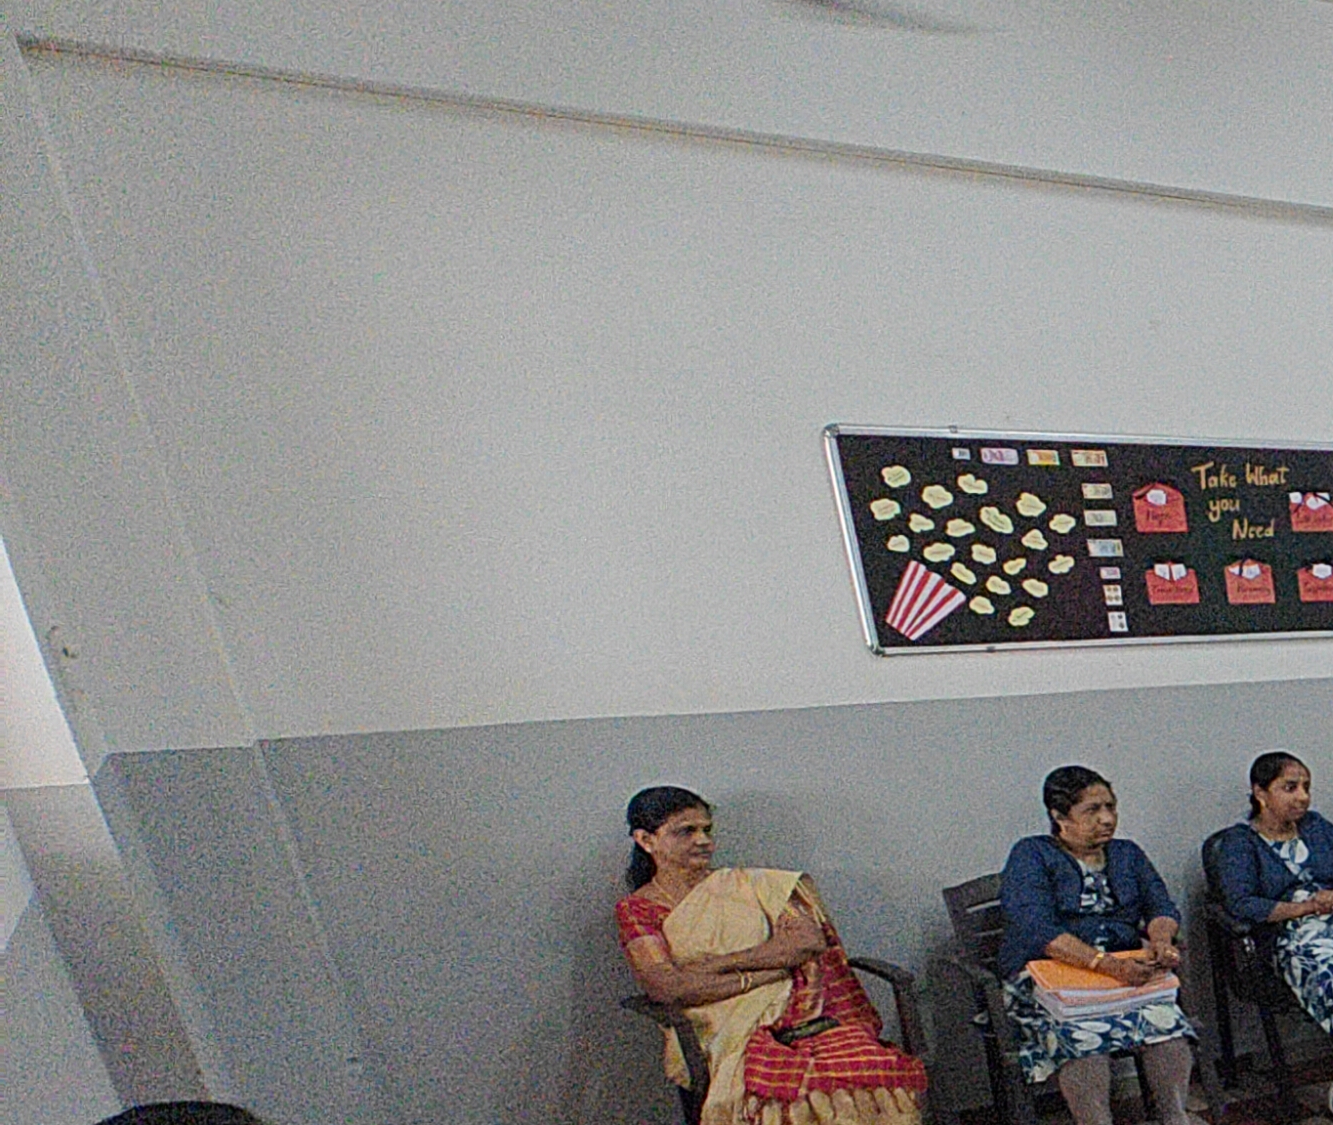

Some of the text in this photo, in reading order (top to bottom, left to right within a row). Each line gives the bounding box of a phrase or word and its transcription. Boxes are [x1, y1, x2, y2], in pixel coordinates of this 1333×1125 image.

[1190, 461, 1290, 490] Take What
[1207, 499, 1240, 523] you
[1232, 517, 1275, 540] Need
